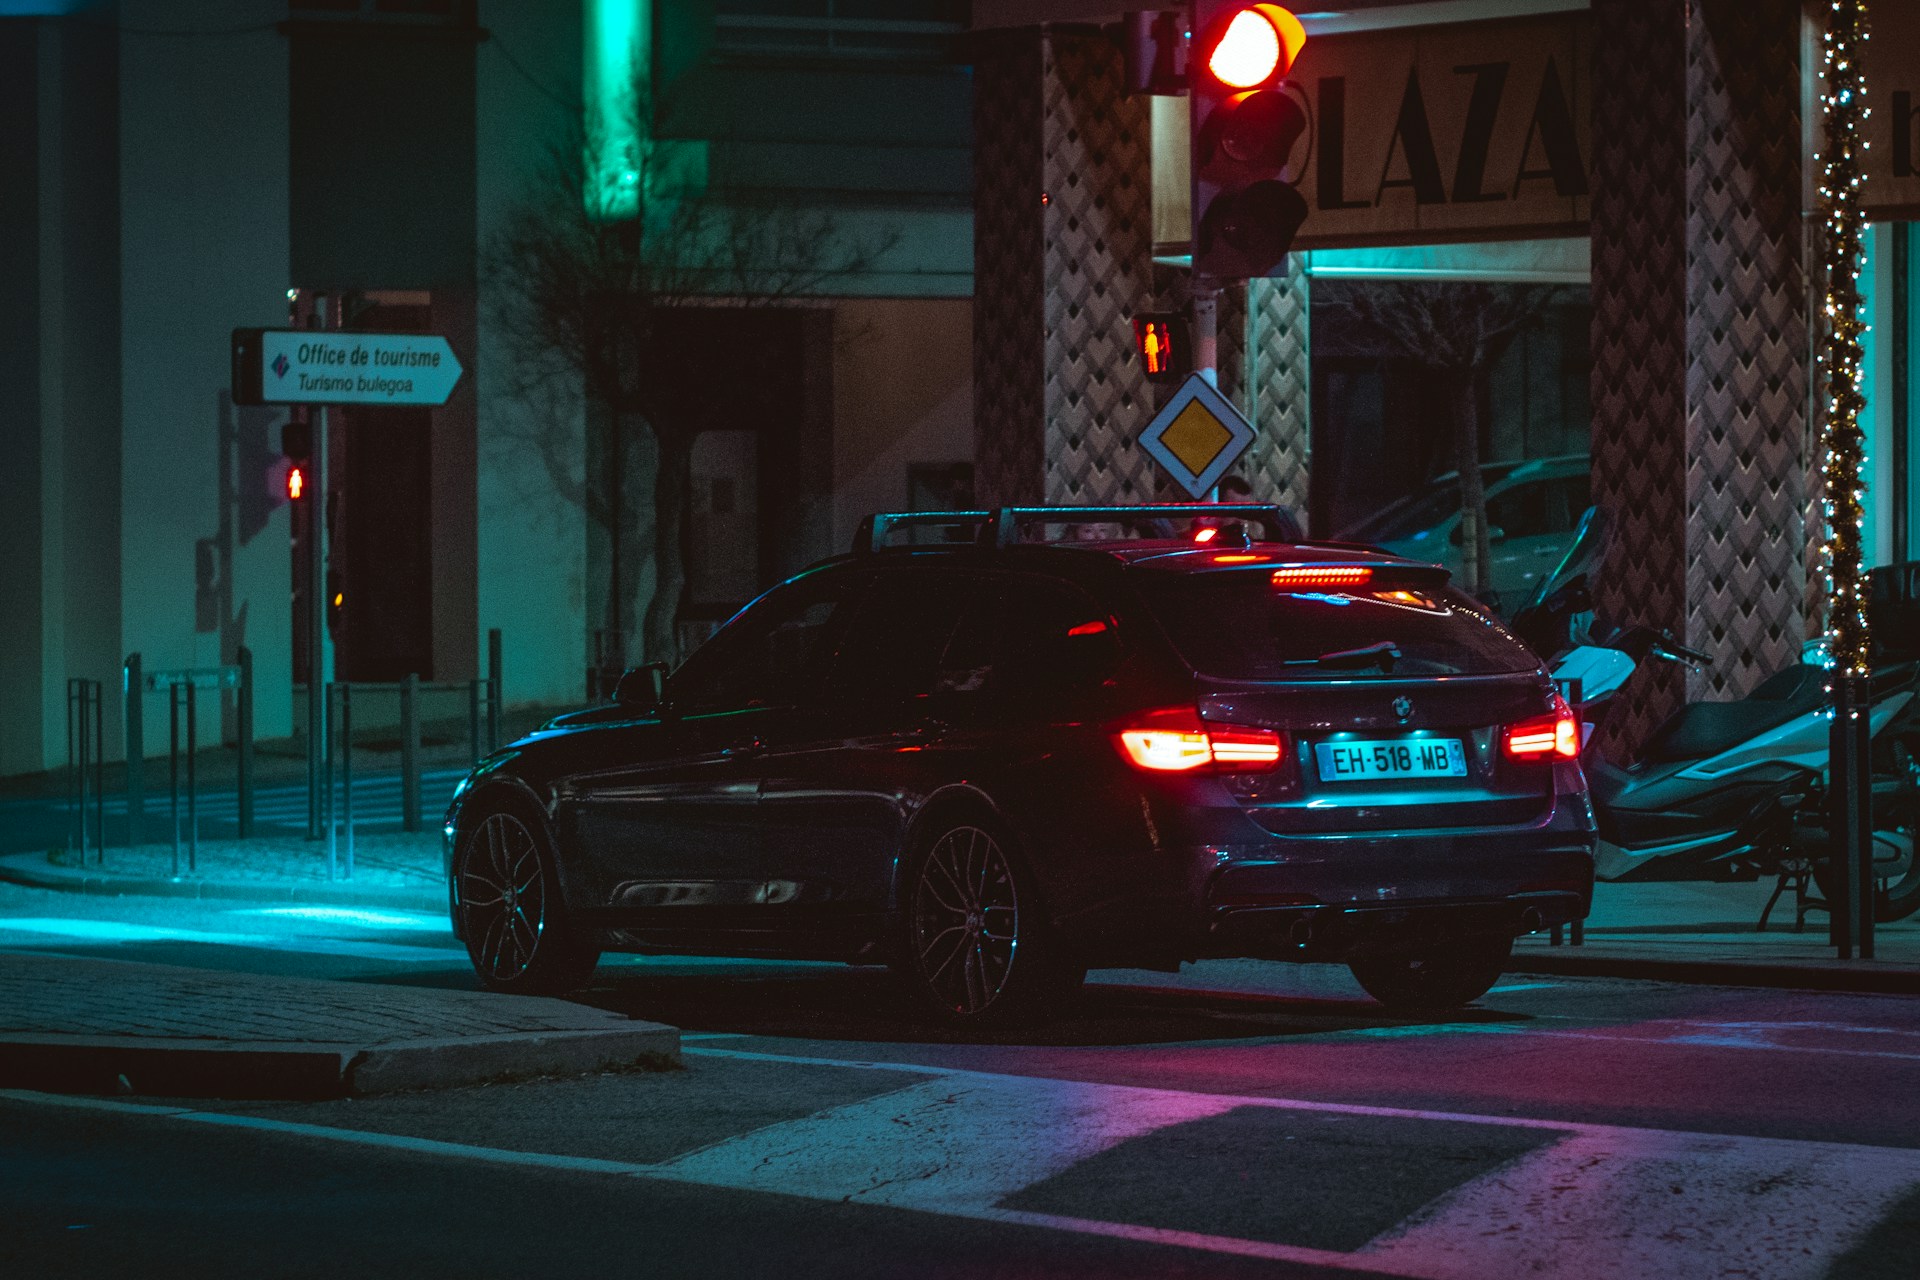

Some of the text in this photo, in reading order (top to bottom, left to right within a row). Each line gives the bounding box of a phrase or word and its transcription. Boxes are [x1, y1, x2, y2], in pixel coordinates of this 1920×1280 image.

[298, 343, 440, 367] Office de tourisme
[299, 373, 413, 395] Turismo bulegoa
[1333, 745, 1449, 774] EH-518-MB
